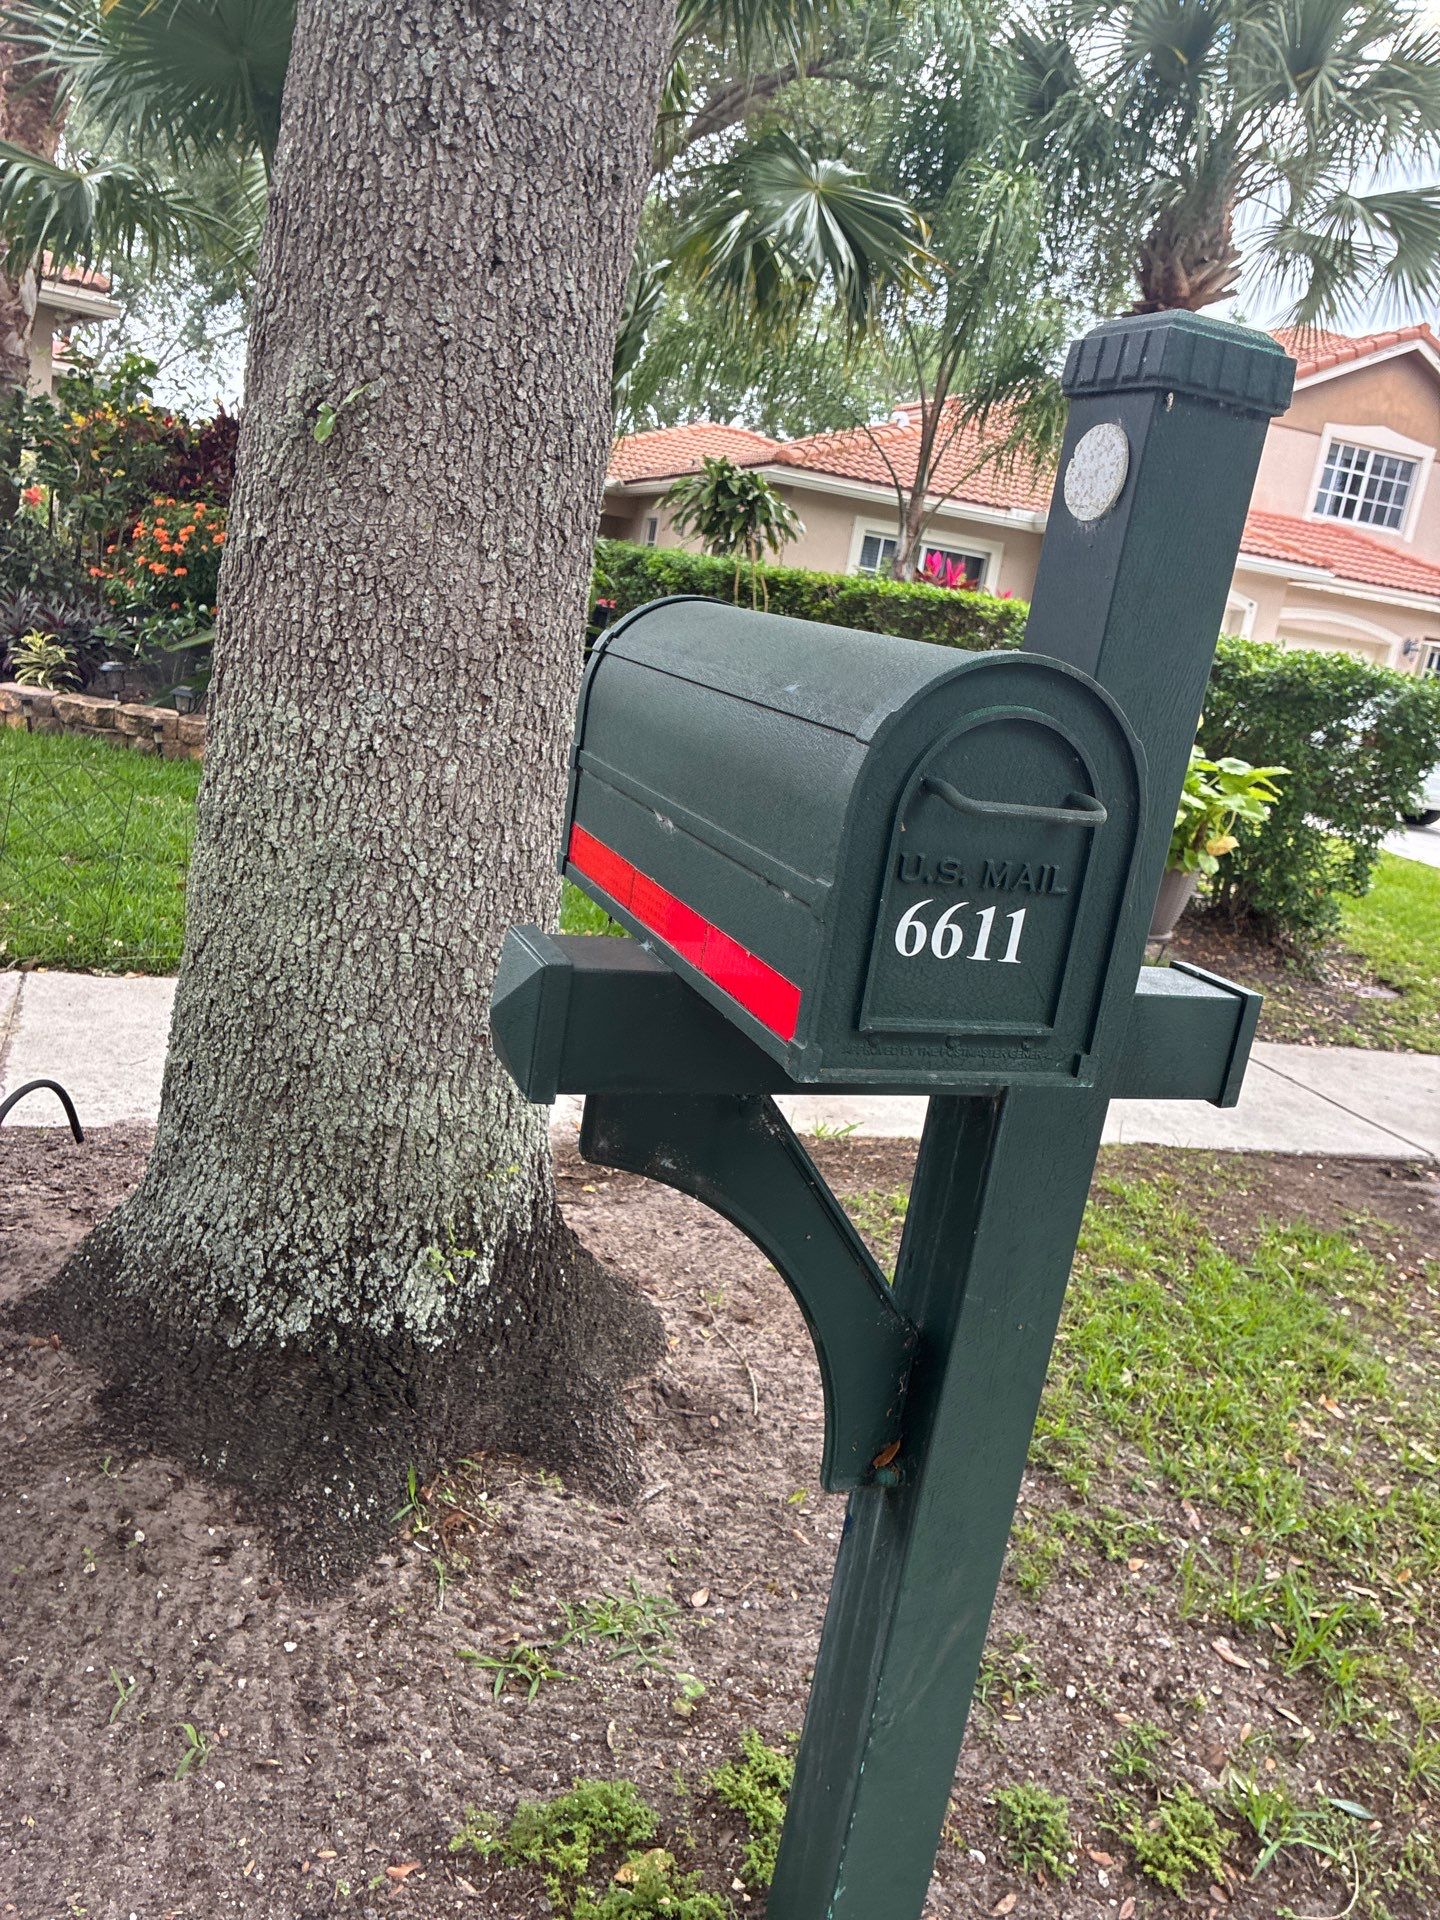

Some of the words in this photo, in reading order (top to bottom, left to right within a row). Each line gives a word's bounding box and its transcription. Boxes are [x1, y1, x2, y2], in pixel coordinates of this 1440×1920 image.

[898, 853, 969, 887] U.S.
[983, 859, 1068, 894] MAIL
[895, 898, 1026, 964] 6611
